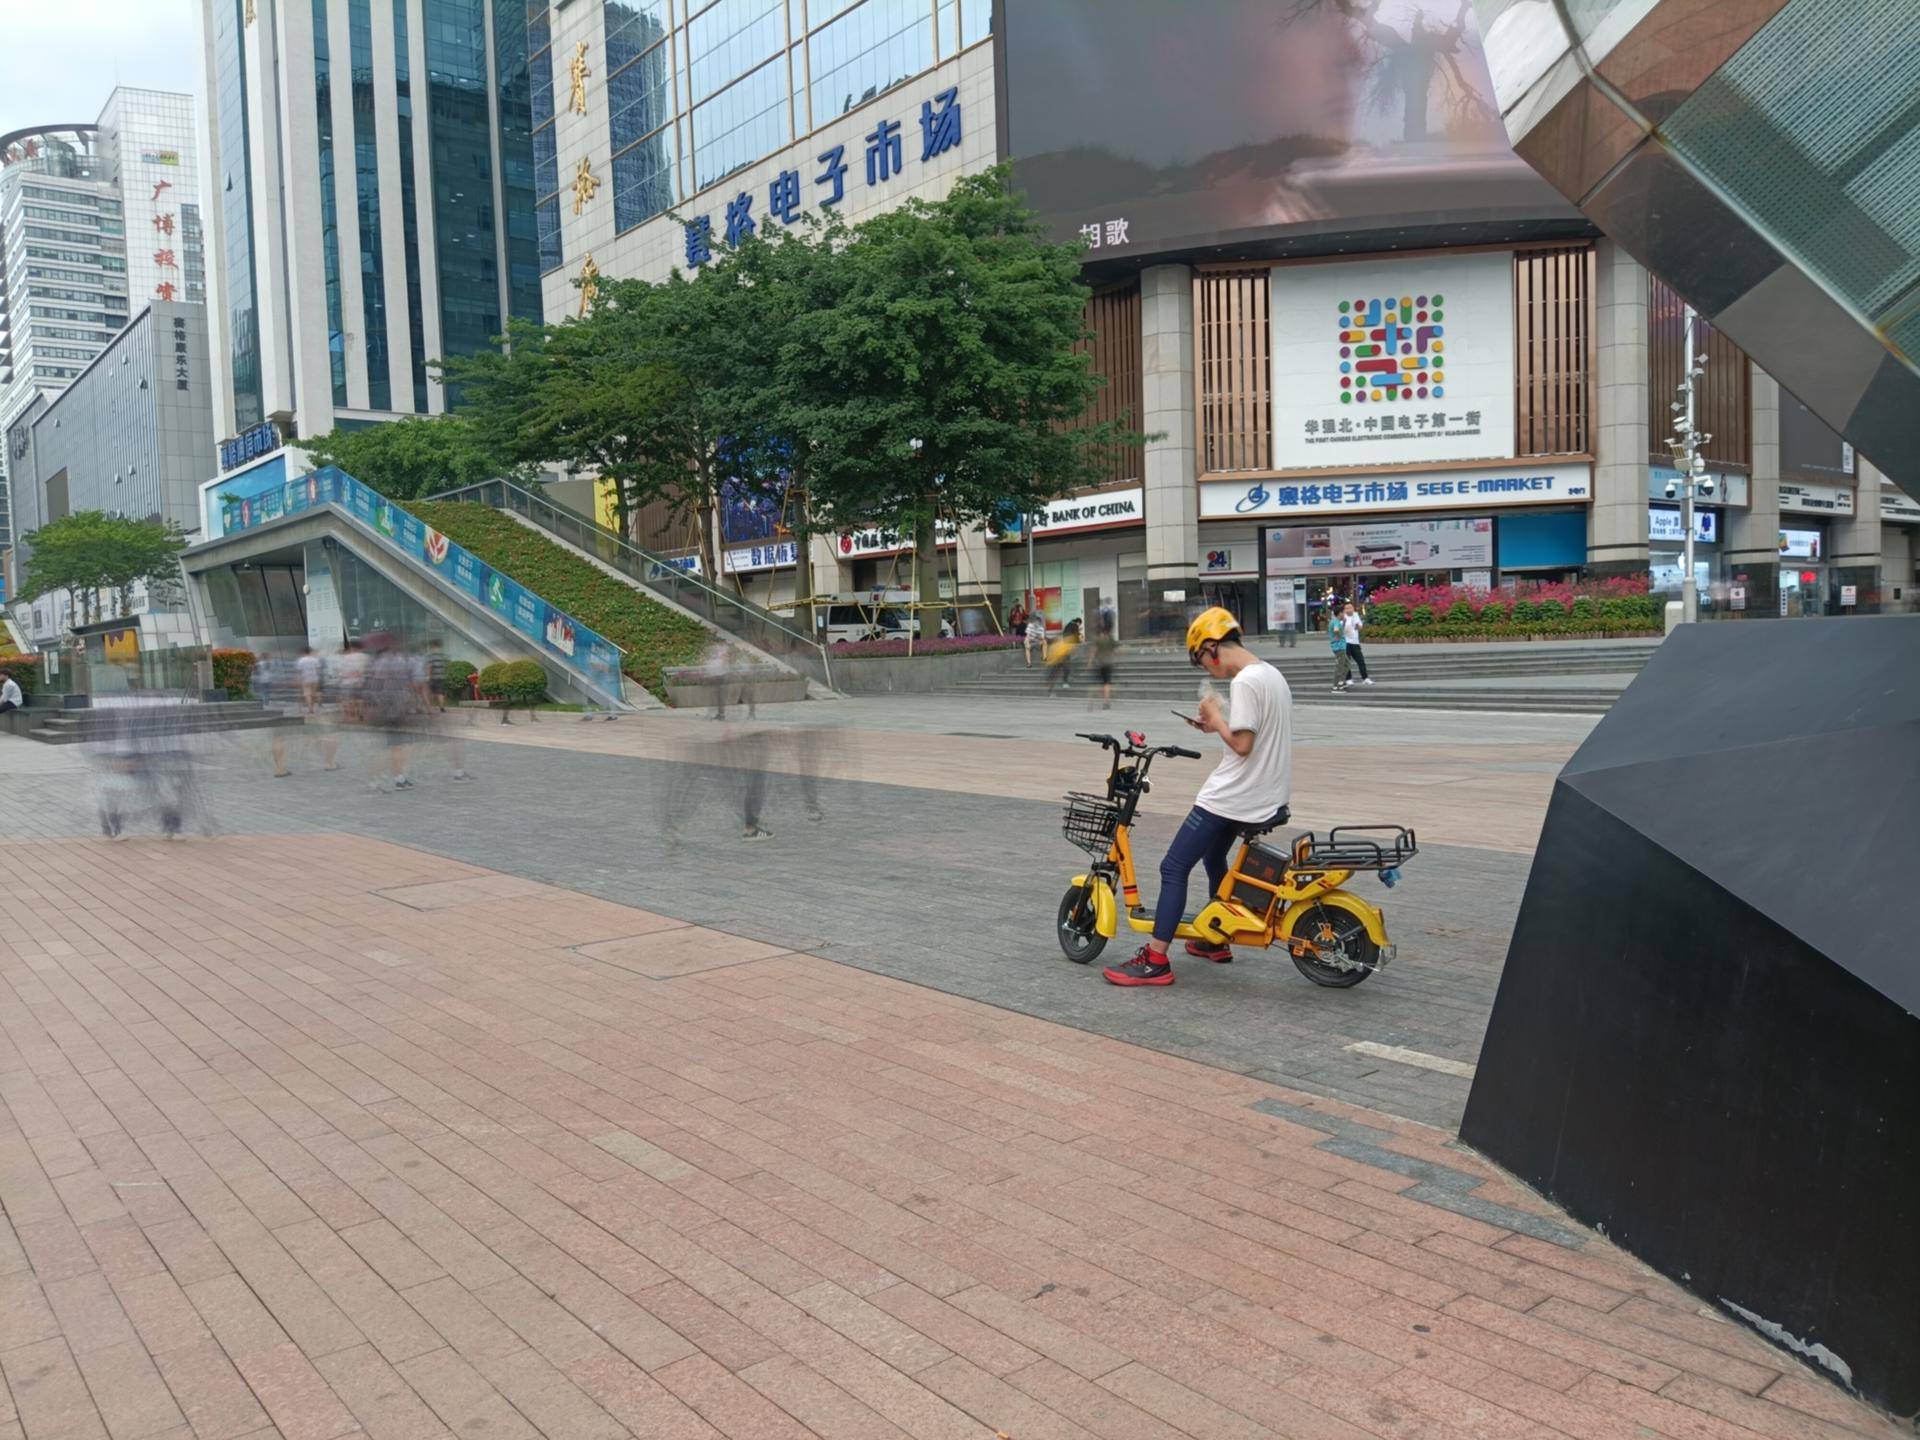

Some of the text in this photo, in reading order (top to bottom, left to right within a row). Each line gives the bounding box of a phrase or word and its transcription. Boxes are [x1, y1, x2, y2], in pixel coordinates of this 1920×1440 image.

[684, 86, 962, 270] 赛格电子市场
[1079, 217, 1130, 250] 胡歌
[1278, 481, 1409, 506] 赛格电子市场
[1416, 482, 1454, 496] SEG
[1457, 476, 1556, 495] E-MARKET
[1052, 508, 1080, 523] BANK
[1082, 506, 1096, 518] OF
[1098, 500, 1135, 517] CHINA
[1207, 550, 1227, 568] 24
